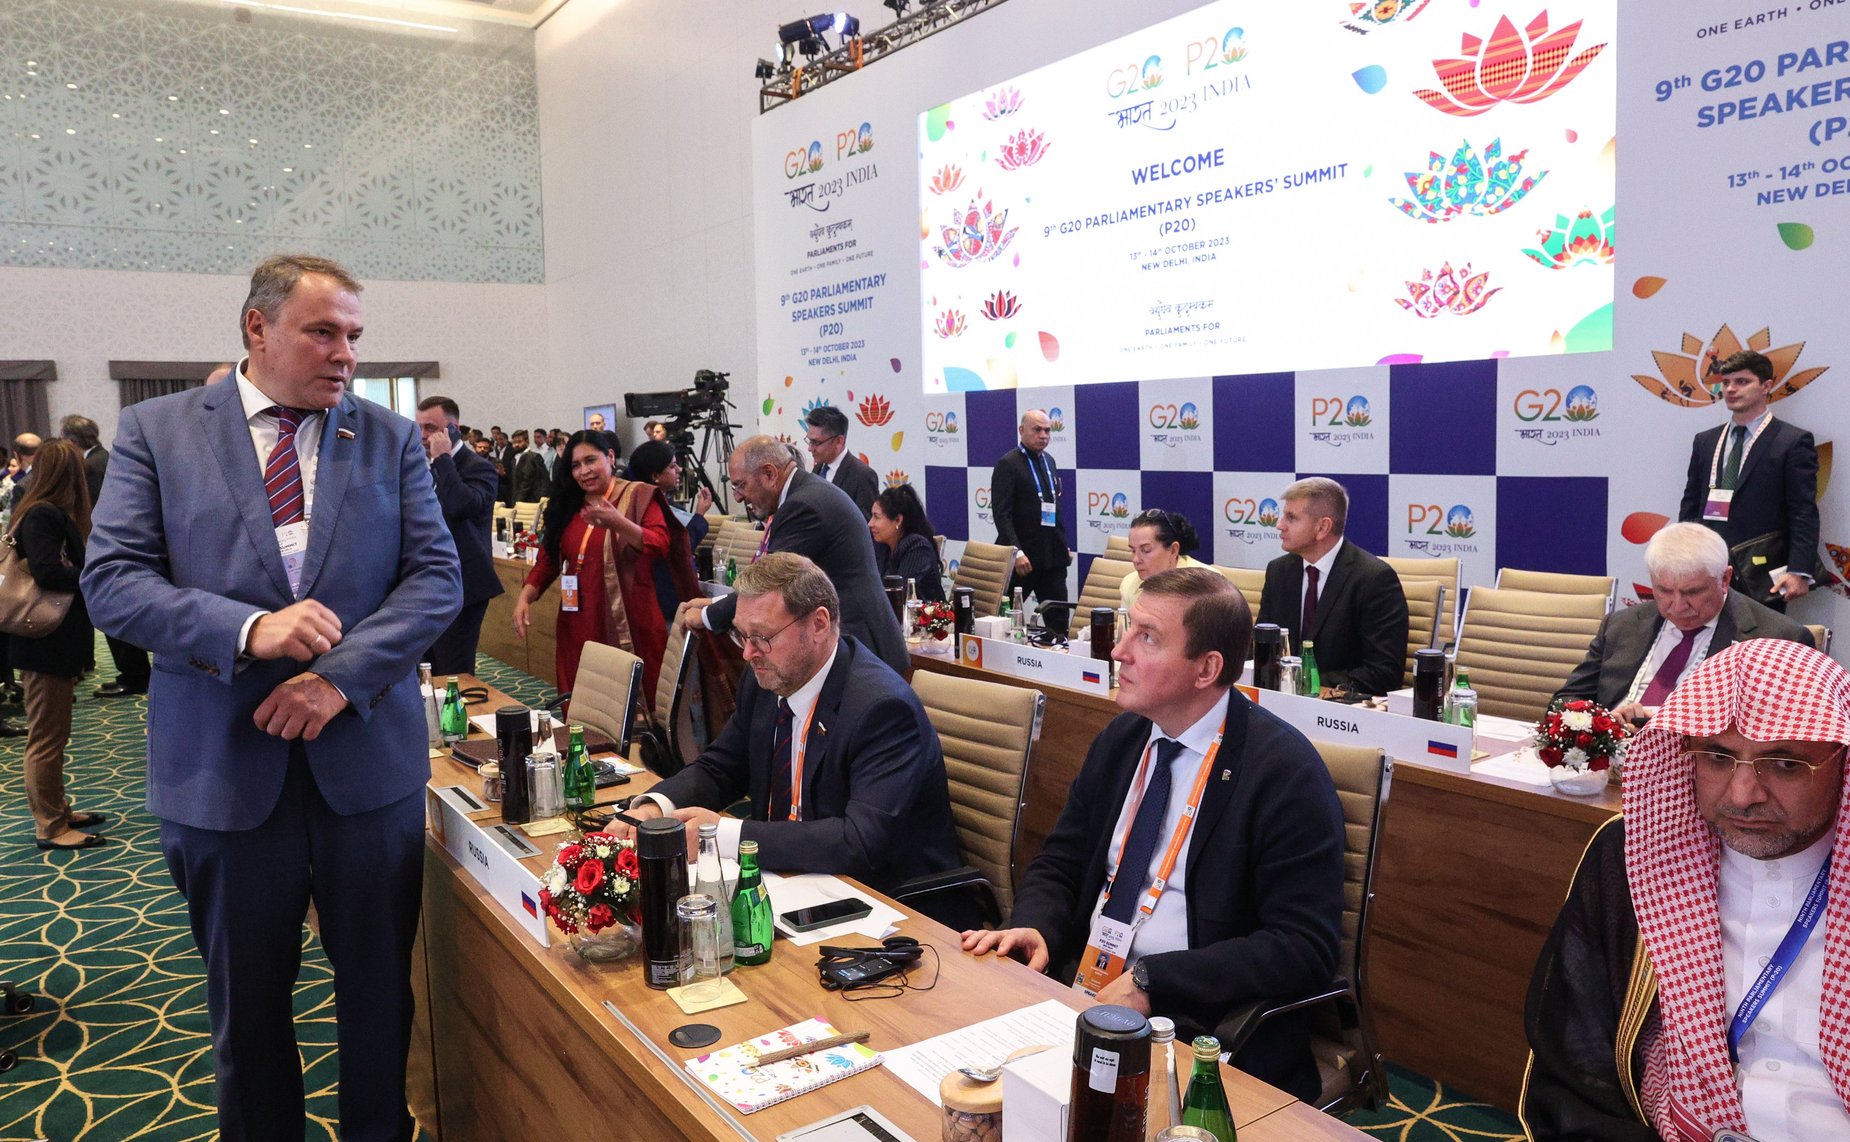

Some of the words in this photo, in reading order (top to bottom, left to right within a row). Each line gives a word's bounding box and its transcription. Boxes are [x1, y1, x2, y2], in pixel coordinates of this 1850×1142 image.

[1696, 22, 1728, 38] ONE
[1734, 7, 1788, 30] EARTH
[1655, 74, 1692, 102] 9th
[1701, 59, 1766, 92] G20
[1160, 93, 1197, 115] 2023
[1203, 74, 1251, 101] INDIA
[1809, 116, 1850, 147] (P
[784, 140, 824, 179] G20
[836, 122, 875, 161] P20
[1132, 148, 1225, 185] WELCOME
[1727, 170, 1760, 188] 13th
[1779, 161, 1815, 181] 14th
[818, 178, 844, 198] 2023
[846, 163, 878, 187] INDIA
[1060, 220, 1082, 234] G20
[1085, 196, 1192, 229] PARLIAMENTARY
[1283, 163, 1348, 189] SUMMIT
[1757, 185, 1809, 206] NEW
[1159, 217, 1196, 237] (P20)
[806, 242, 844, 258] PARLIAMENTS
[844, 239, 857, 250] FOR
[1164, 241, 1206, 255] OCTOBER
[1208, 236, 1230, 248] 2023
[1141, 261, 1160, 271] NEW
[1192, 253, 1217, 263] INDIA
[792, 290, 809, 304] G20
[810, 273, 887, 300] PARLIAMENTARY
[791, 303, 836, 323] SPEAKERS
[837, 296, 874, 315] SUMMIT
[819, 321, 844, 338] (P20)
[1145, 323, 1201, 336] PARLIAMENTS
[1203, 321, 1221, 331] FOR
[823, 341, 850, 353] OCTOBER
[850, 339, 865, 350] 2023
[808, 358, 821, 367] NEW
[840, 353, 857, 363] INDIA
[1150, 401, 1200, 431] G20
[1312, 395, 1373, 427] P20
[1514, 384, 1600, 422] G20
[925, 411, 959, 433] G20
[1547, 431, 1570, 441] 2023
[1572, 428, 1600, 437] INDIA
[1334, 434, 1351, 443] 2023
[1352, 432, 1374, 440] INDIA
[1088, 492, 1129, 518] P20
[1408, 503, 1476, 539] P20
[1432, 544, 1452, 553] 2023
[1454, 543, 1478, 552] INDIA
[1017, 656, 1043, 669] RUSSIA
[1317, 715, 1359, 734] RUSSIA
[468, 840, 490, 870] RUSSIA
[1737, 1000, 1749, 1018] NINTH
[1747, 963, 1775, 1003] PARLIAMENTARY
[1742, 998, 1760, 1024] SPEAKERS
[1757, 980, 1773, 1000] SUMMIT
